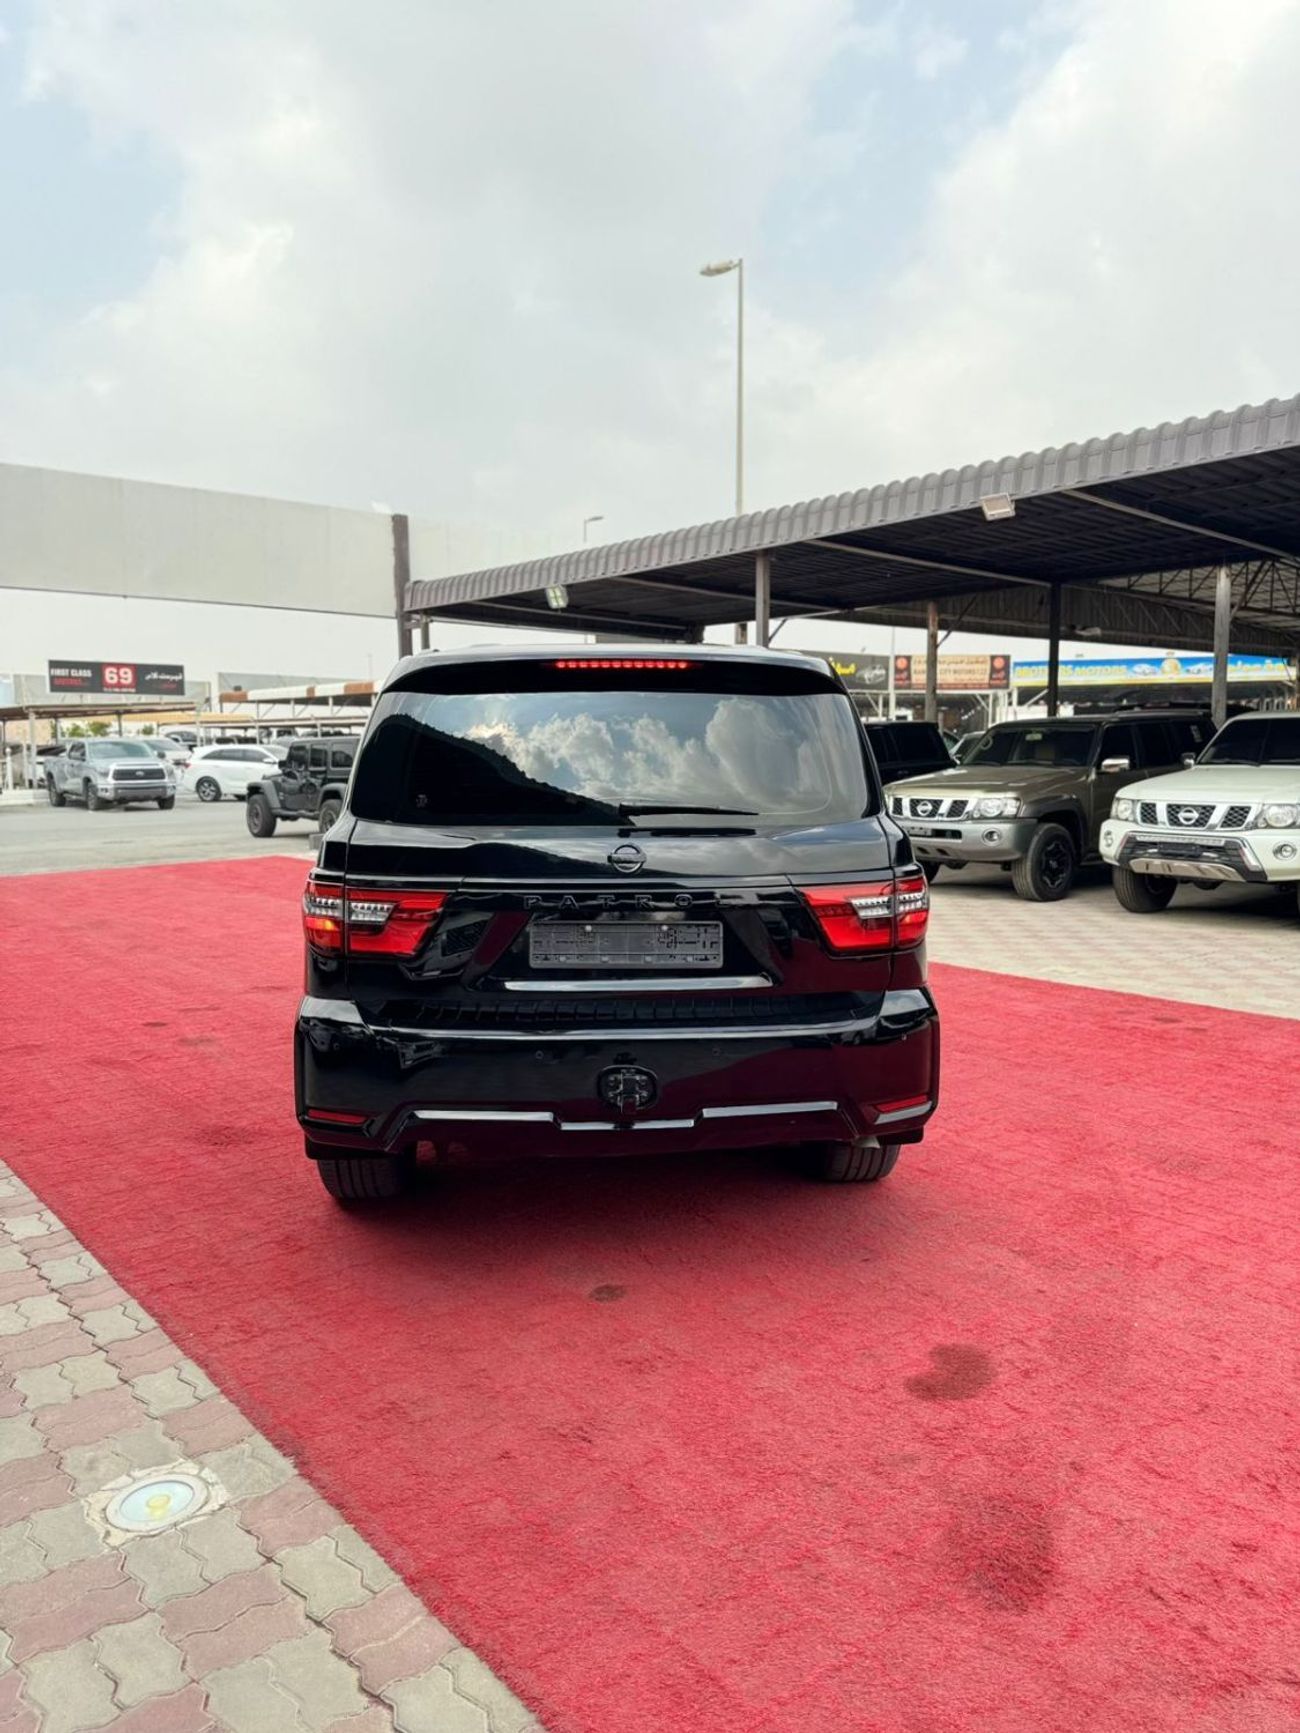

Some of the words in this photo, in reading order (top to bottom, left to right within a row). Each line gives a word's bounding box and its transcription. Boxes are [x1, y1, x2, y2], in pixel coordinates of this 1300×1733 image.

[50, 669, 69, 677] FIRST
[71, 669, 92, 677] CLASS
[105, 667, 133, 685] 69
[1075, 665, 1127, 677] MOTORS
[525, 893, 729, 909] PATROL
